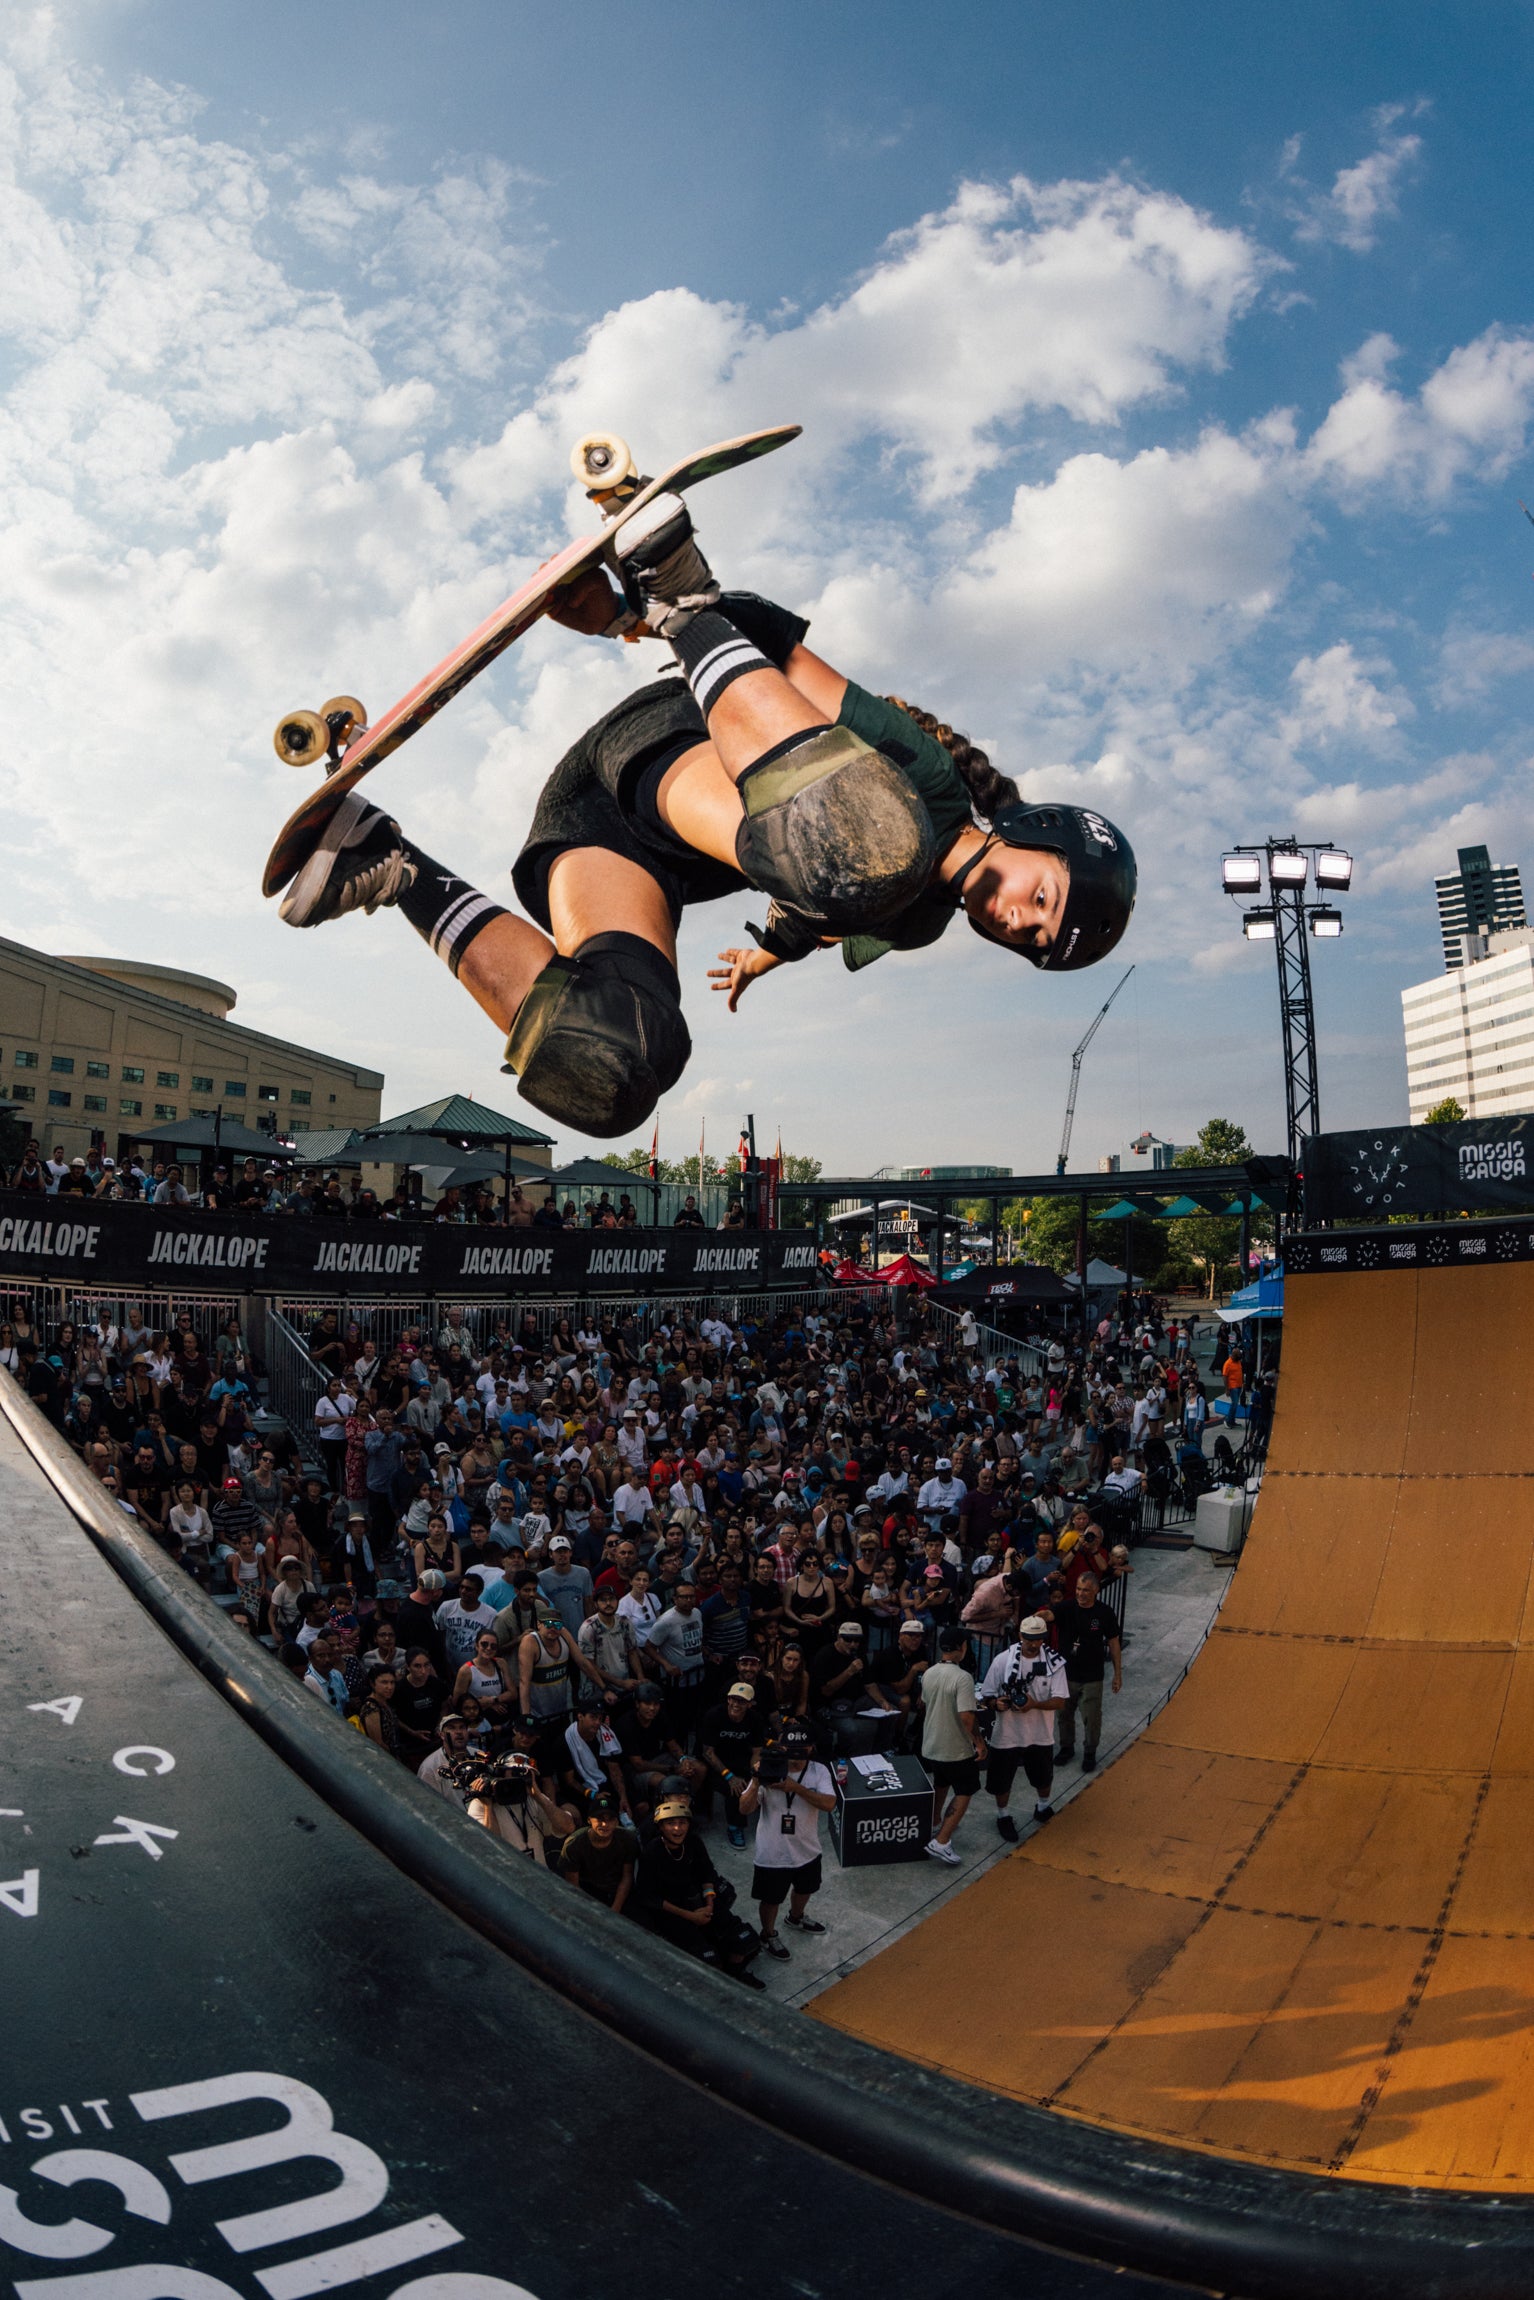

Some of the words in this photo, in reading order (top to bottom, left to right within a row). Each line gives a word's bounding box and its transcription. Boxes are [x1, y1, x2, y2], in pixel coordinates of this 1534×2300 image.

[147, 1231, 270, 1268] JACKALOPE
[313, 1242, 423, 1274] JACKALOPE
[459, 1247, 554, 1275] JACKALOPE
[586, 1248, 667, 1274] JACKALOPE
[692, 1247, 760, 1272] JACKALOPE
